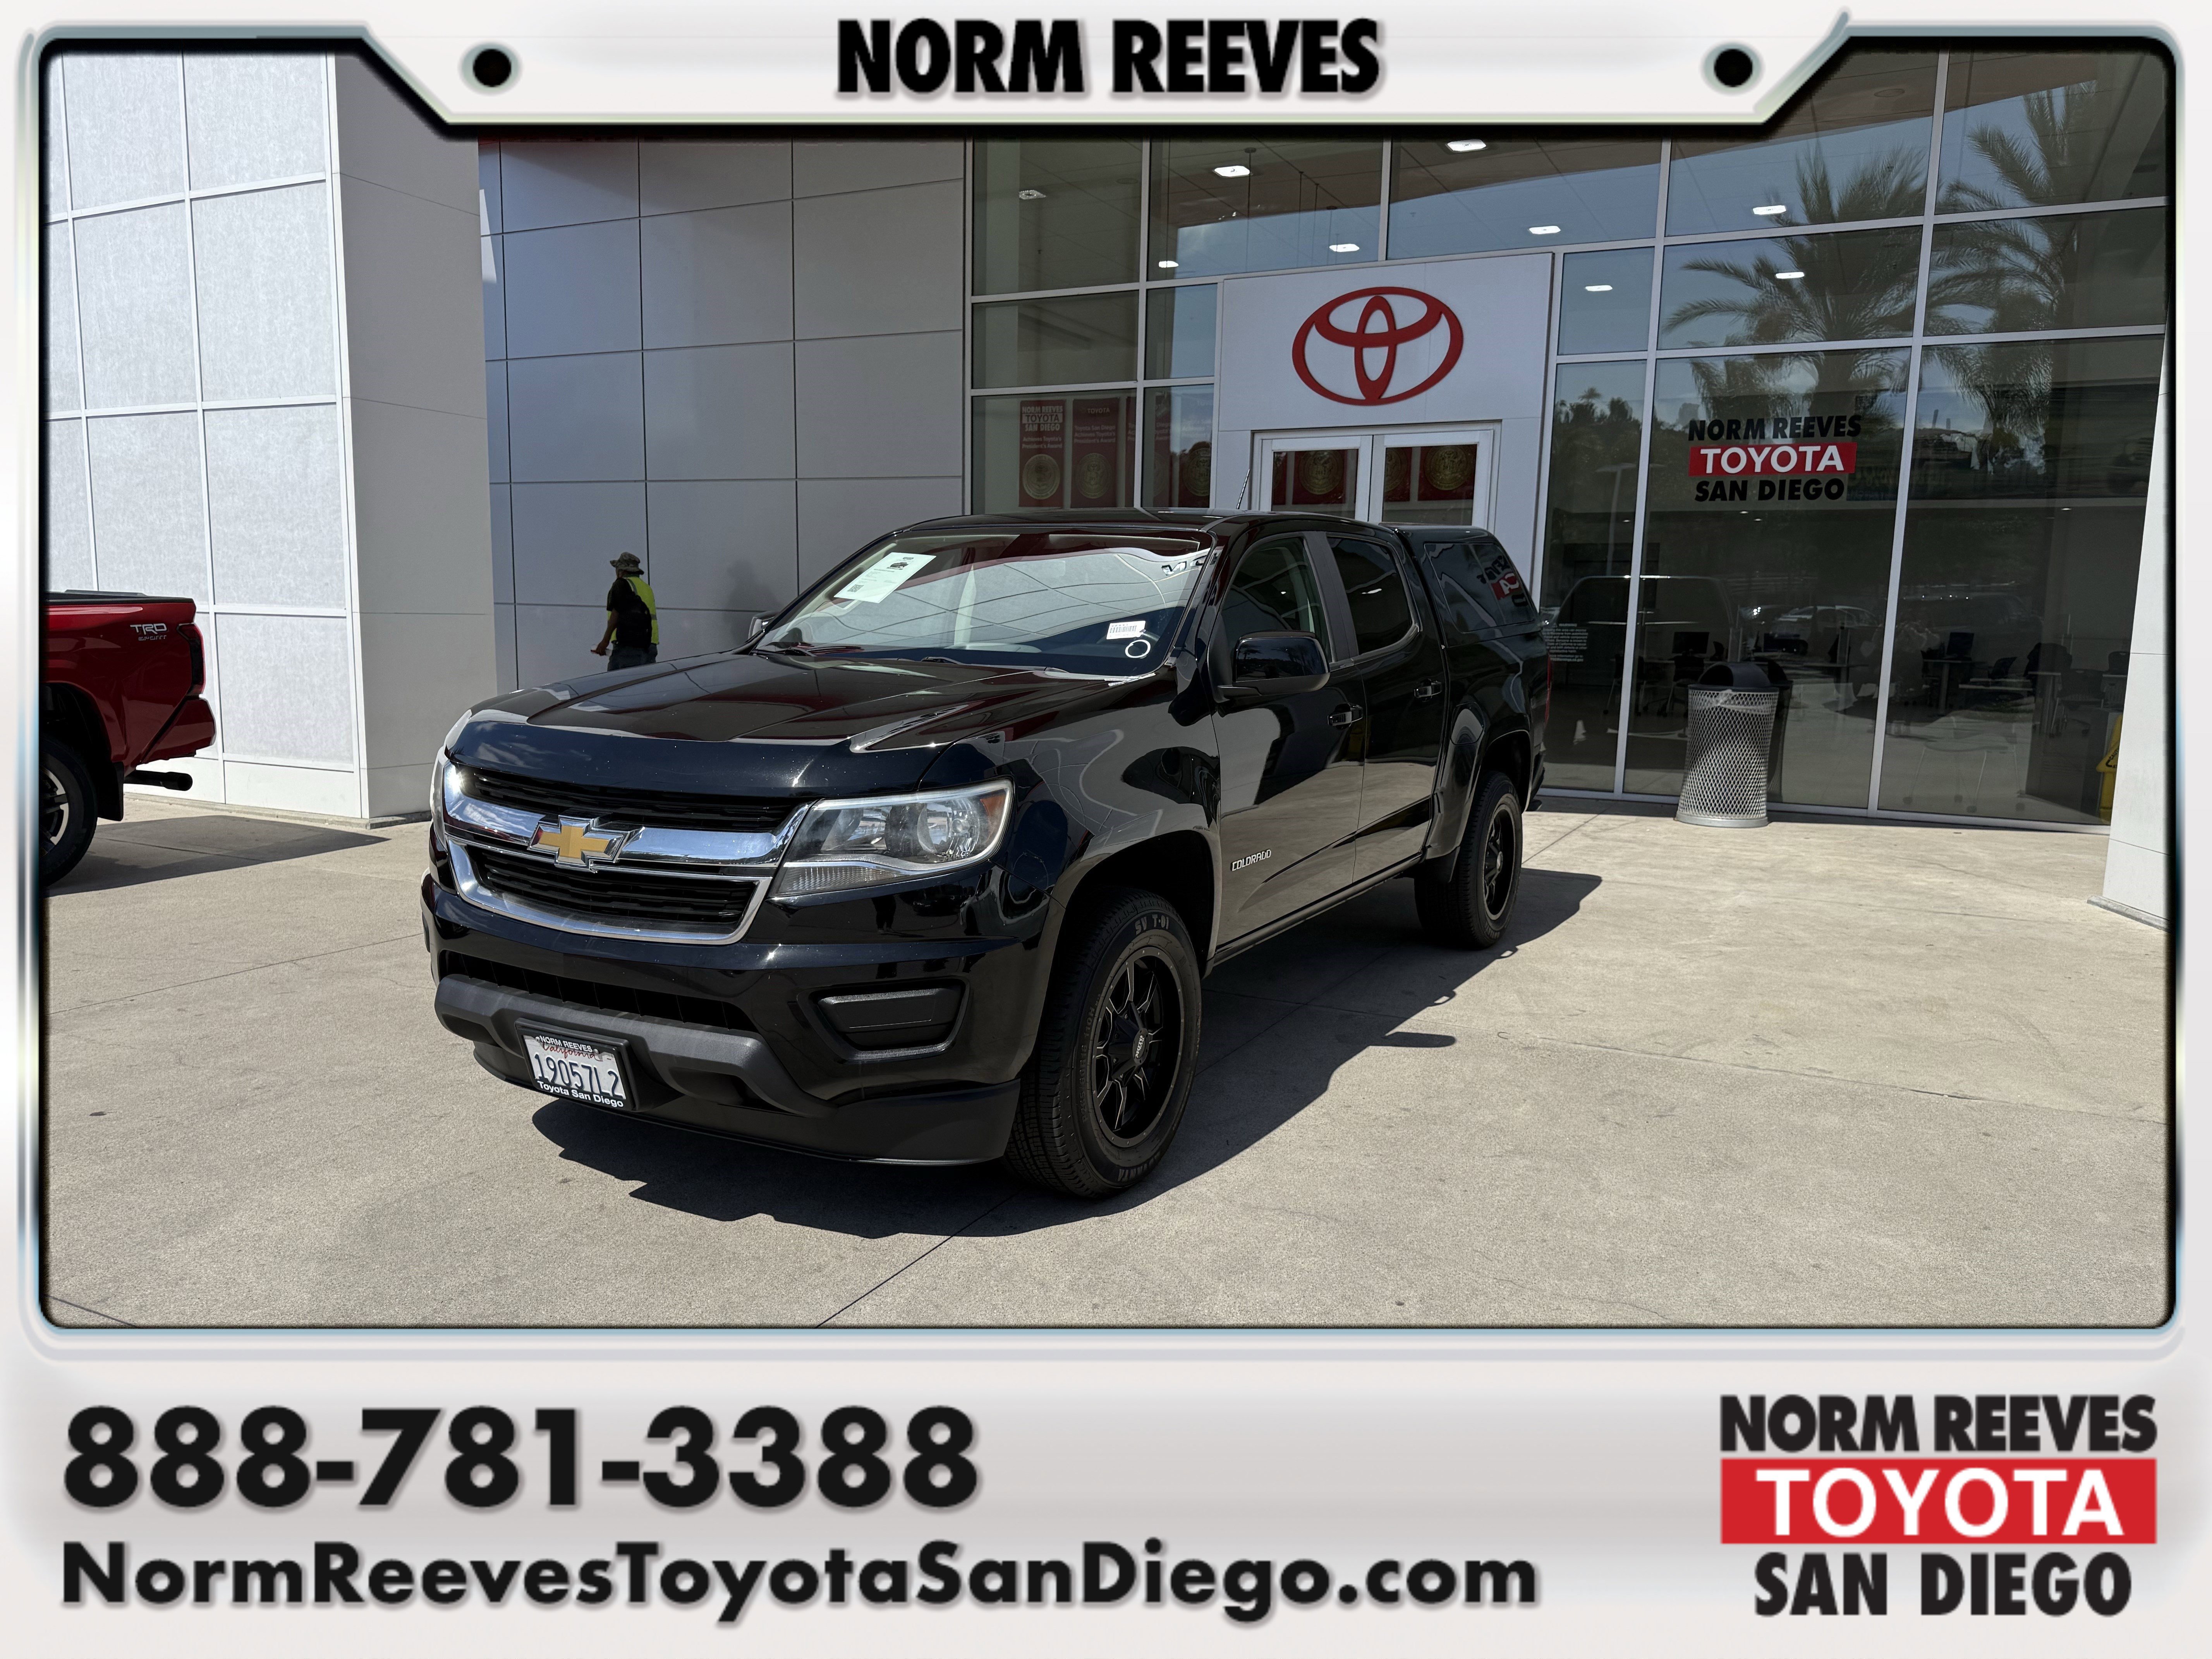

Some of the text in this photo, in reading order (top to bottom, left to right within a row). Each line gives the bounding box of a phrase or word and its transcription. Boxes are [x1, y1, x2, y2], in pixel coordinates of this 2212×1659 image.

[1025, 414, 1059, 422] TOYOTA
[1025, 423, 1060, 432] SAN DIEGO
[1688, 415, 1862, 441] NORM REEVES
[1700, 445, 1844, 474] TOYOTA
[1695, 480, 1748, 502] SAN
[1758, 478, 1844, 501] DIEGO
[130, 623, 167, 635] TRD
[1231, 849, 1271, 871] COLORADO
[1135, 916, 1147, 935] SV
[539, 1035, 593, 1053] NORM REEVES
[542, 1042, 603, 1061] California
[534, 1053, 624, 1099] 19057L2
[537, 1080, 624, 1108] Toyota San Diego
